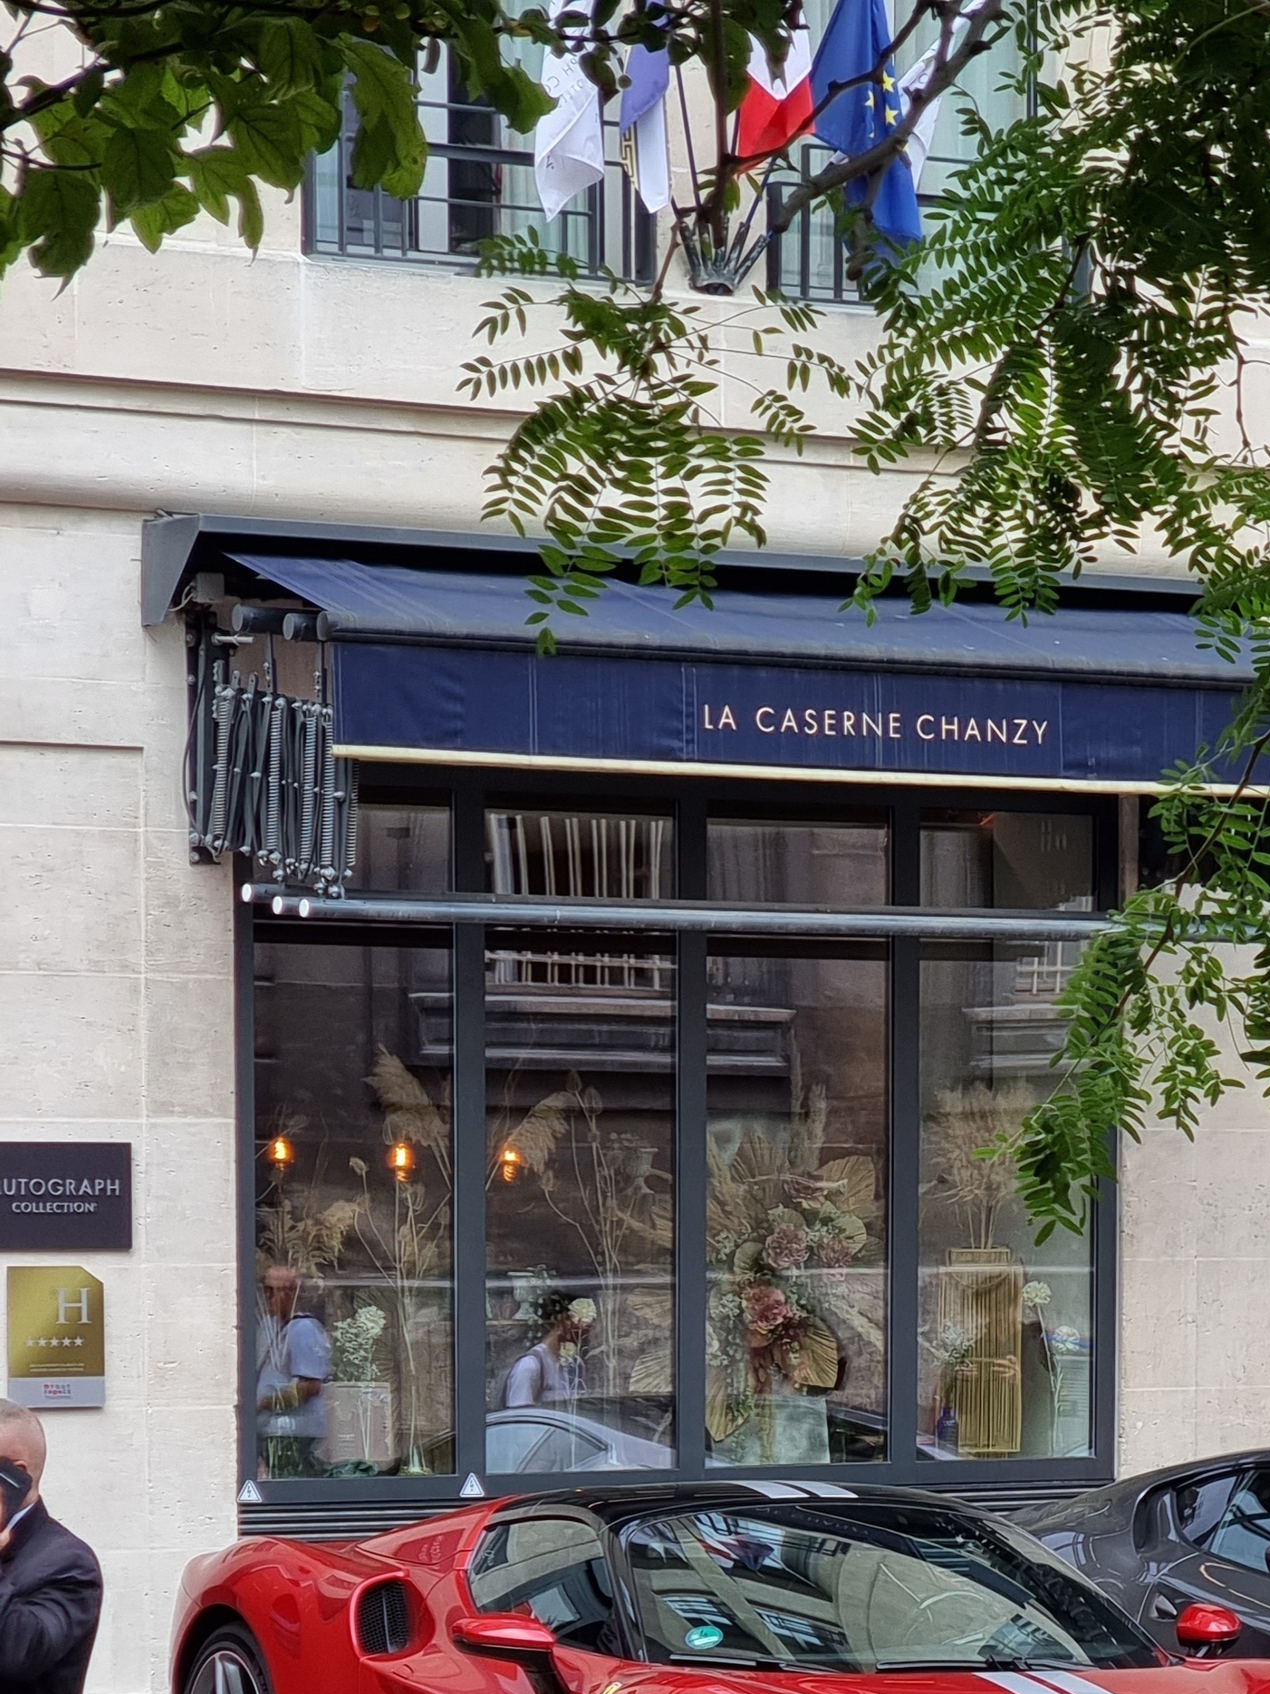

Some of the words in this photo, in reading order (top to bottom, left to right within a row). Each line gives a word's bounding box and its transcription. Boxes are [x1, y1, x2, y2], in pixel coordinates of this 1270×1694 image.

[703, 704, 738, 731] LA
[755, 706, 902, 739] CASERNE
[916, 714, 1048, 745] CHANZY
[0, 1178, 120, 1196] UTOGRAPH
[55, 1287, 92, 1324] H
